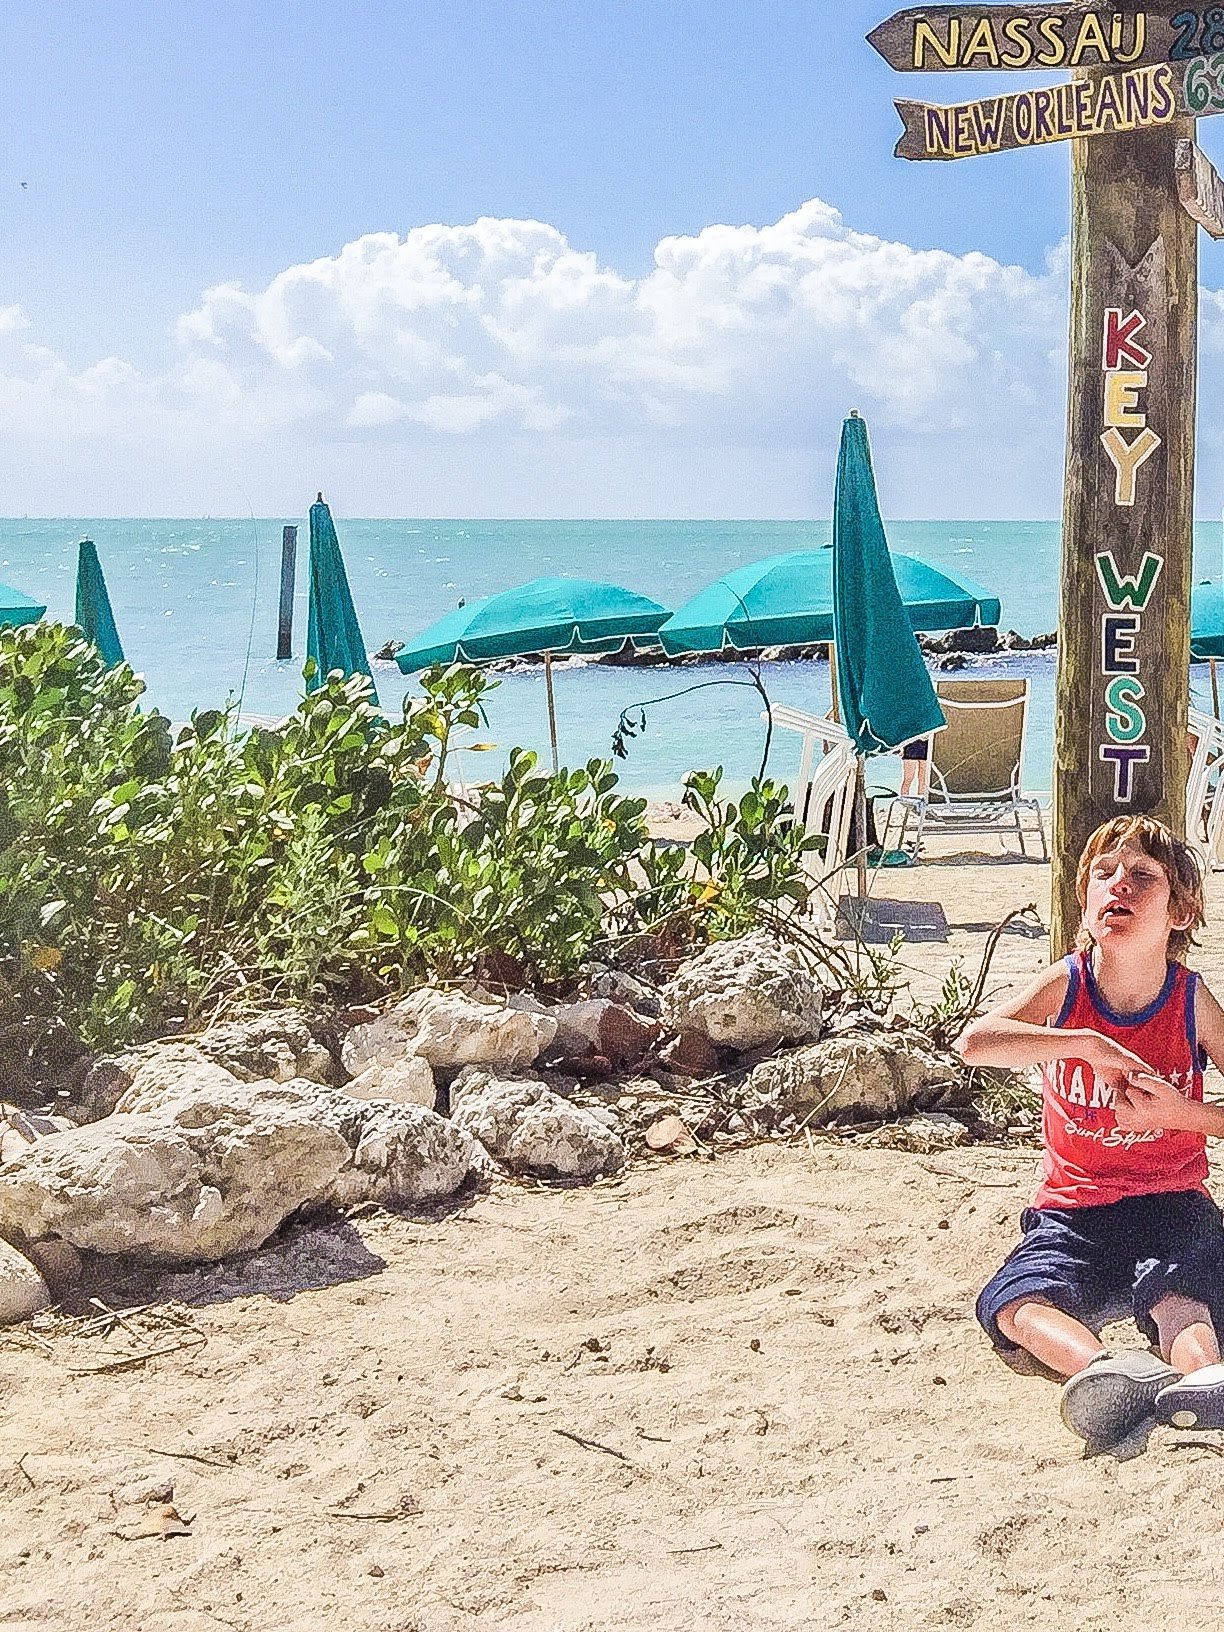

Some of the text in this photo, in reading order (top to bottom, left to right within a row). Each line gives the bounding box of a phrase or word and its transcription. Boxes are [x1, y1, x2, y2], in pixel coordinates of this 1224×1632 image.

[911, 10, 1148, 73] NASSAU
[925, 101, 1011, 156] NEW
[1011, 65, 1177, 145] ORLEANS
[1093, 307, 1165, 803] KEY WEST
[1064, 1116, 1106, 1142] Surf
